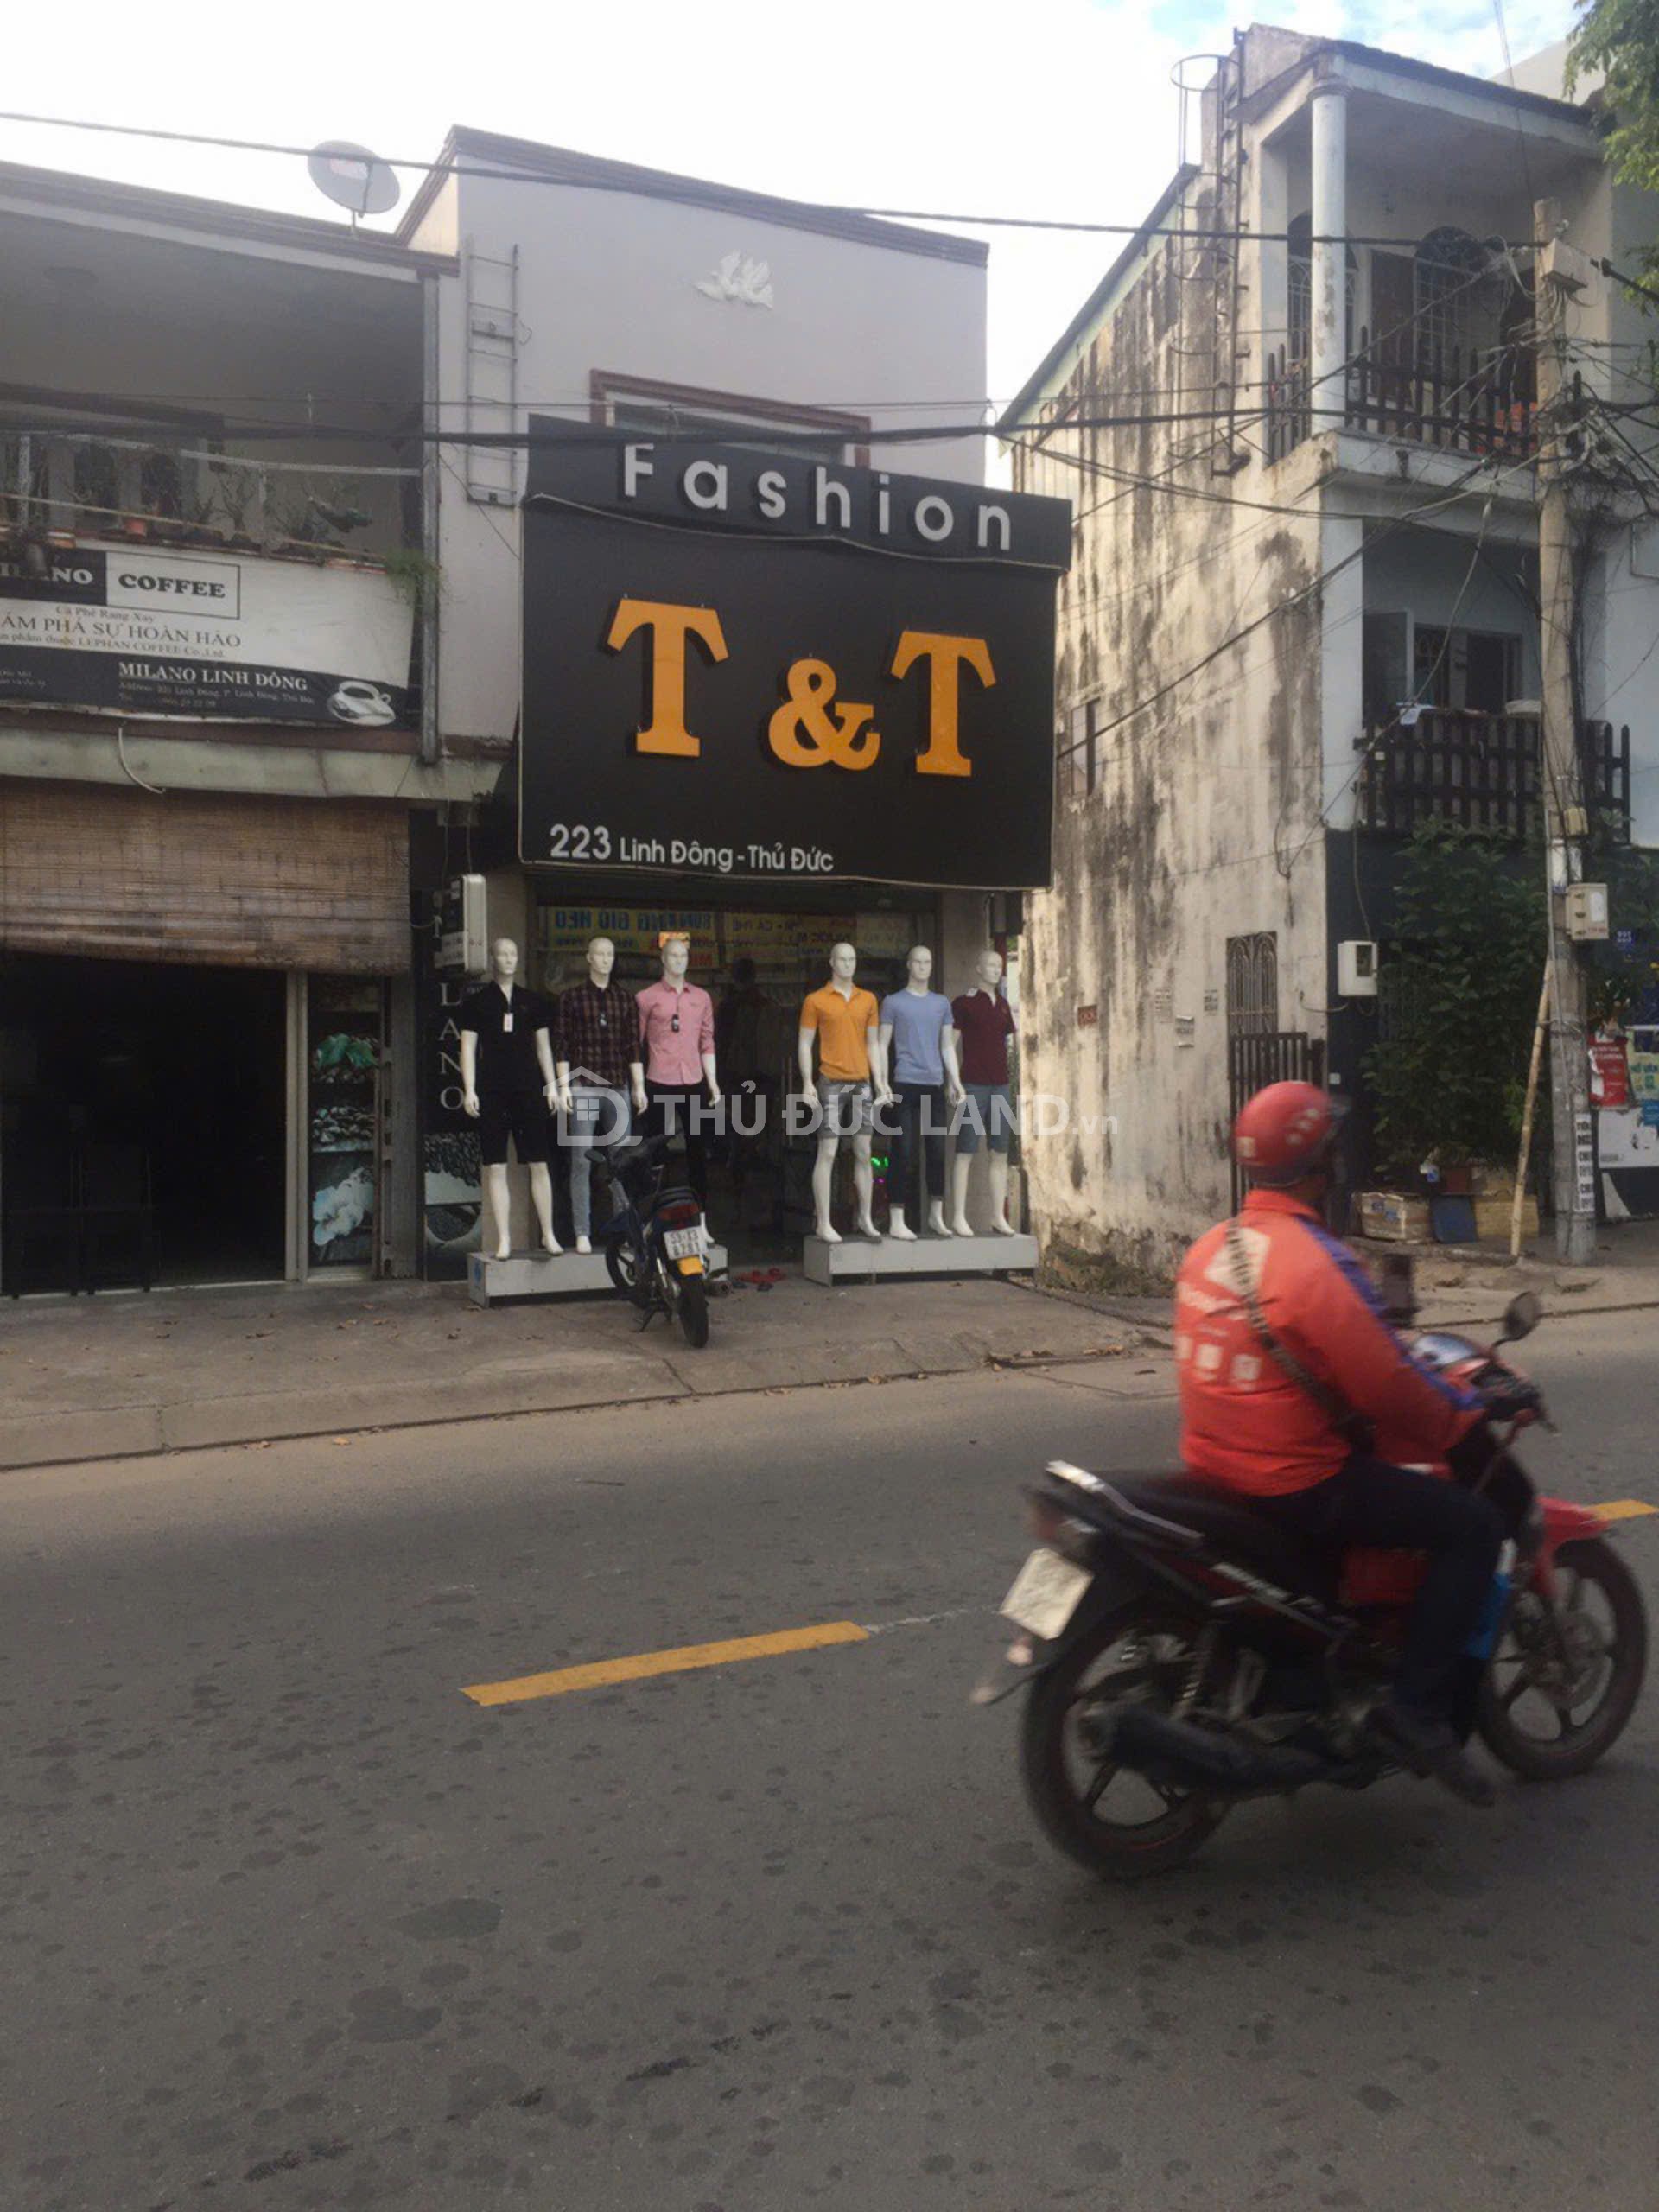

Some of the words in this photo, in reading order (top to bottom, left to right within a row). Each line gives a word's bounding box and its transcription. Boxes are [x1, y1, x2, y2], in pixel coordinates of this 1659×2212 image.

[625, 443, 1011, 550] Fashion
[118, 573, 226, 599] COFFEE
[129, 624, 188, 643] HOÀN
[118, 661, 196, 683] MILANO
[202, 669, 250, 686] LINH
[256, 671, 308, 691] ĐÔNG
[550, 823, 611, 860] 223
[620, 836, 664, 864] Linh
[671, 840, 733, 873] Đông
[747, 842, 785, 869] Thủ
[791, 846, 834, 872] Đức
